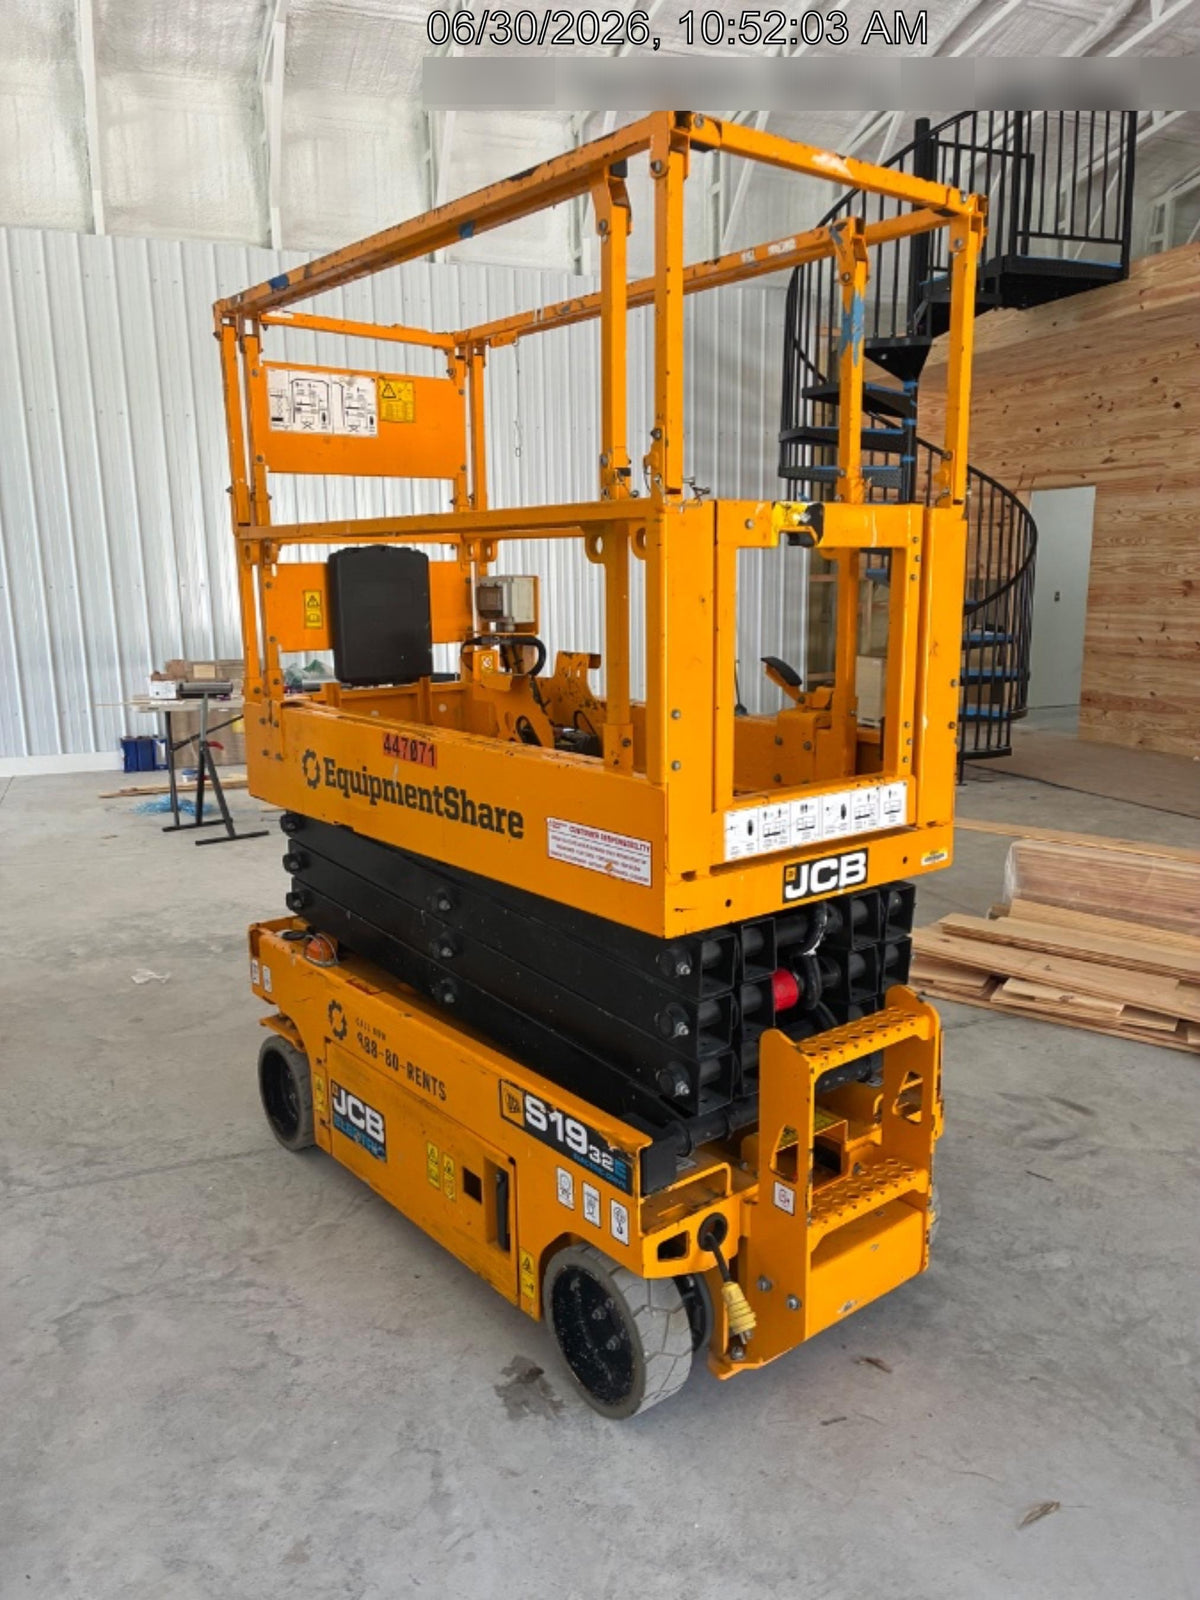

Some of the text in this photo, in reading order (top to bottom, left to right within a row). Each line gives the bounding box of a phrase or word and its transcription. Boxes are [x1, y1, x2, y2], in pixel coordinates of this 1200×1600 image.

[384, 732, 435, 767] 447071
[323, 757, 524, 839] EquipmentShare
[785, 852, 866, 899] JCB
[333, 1089, 385, 1145] JCB
